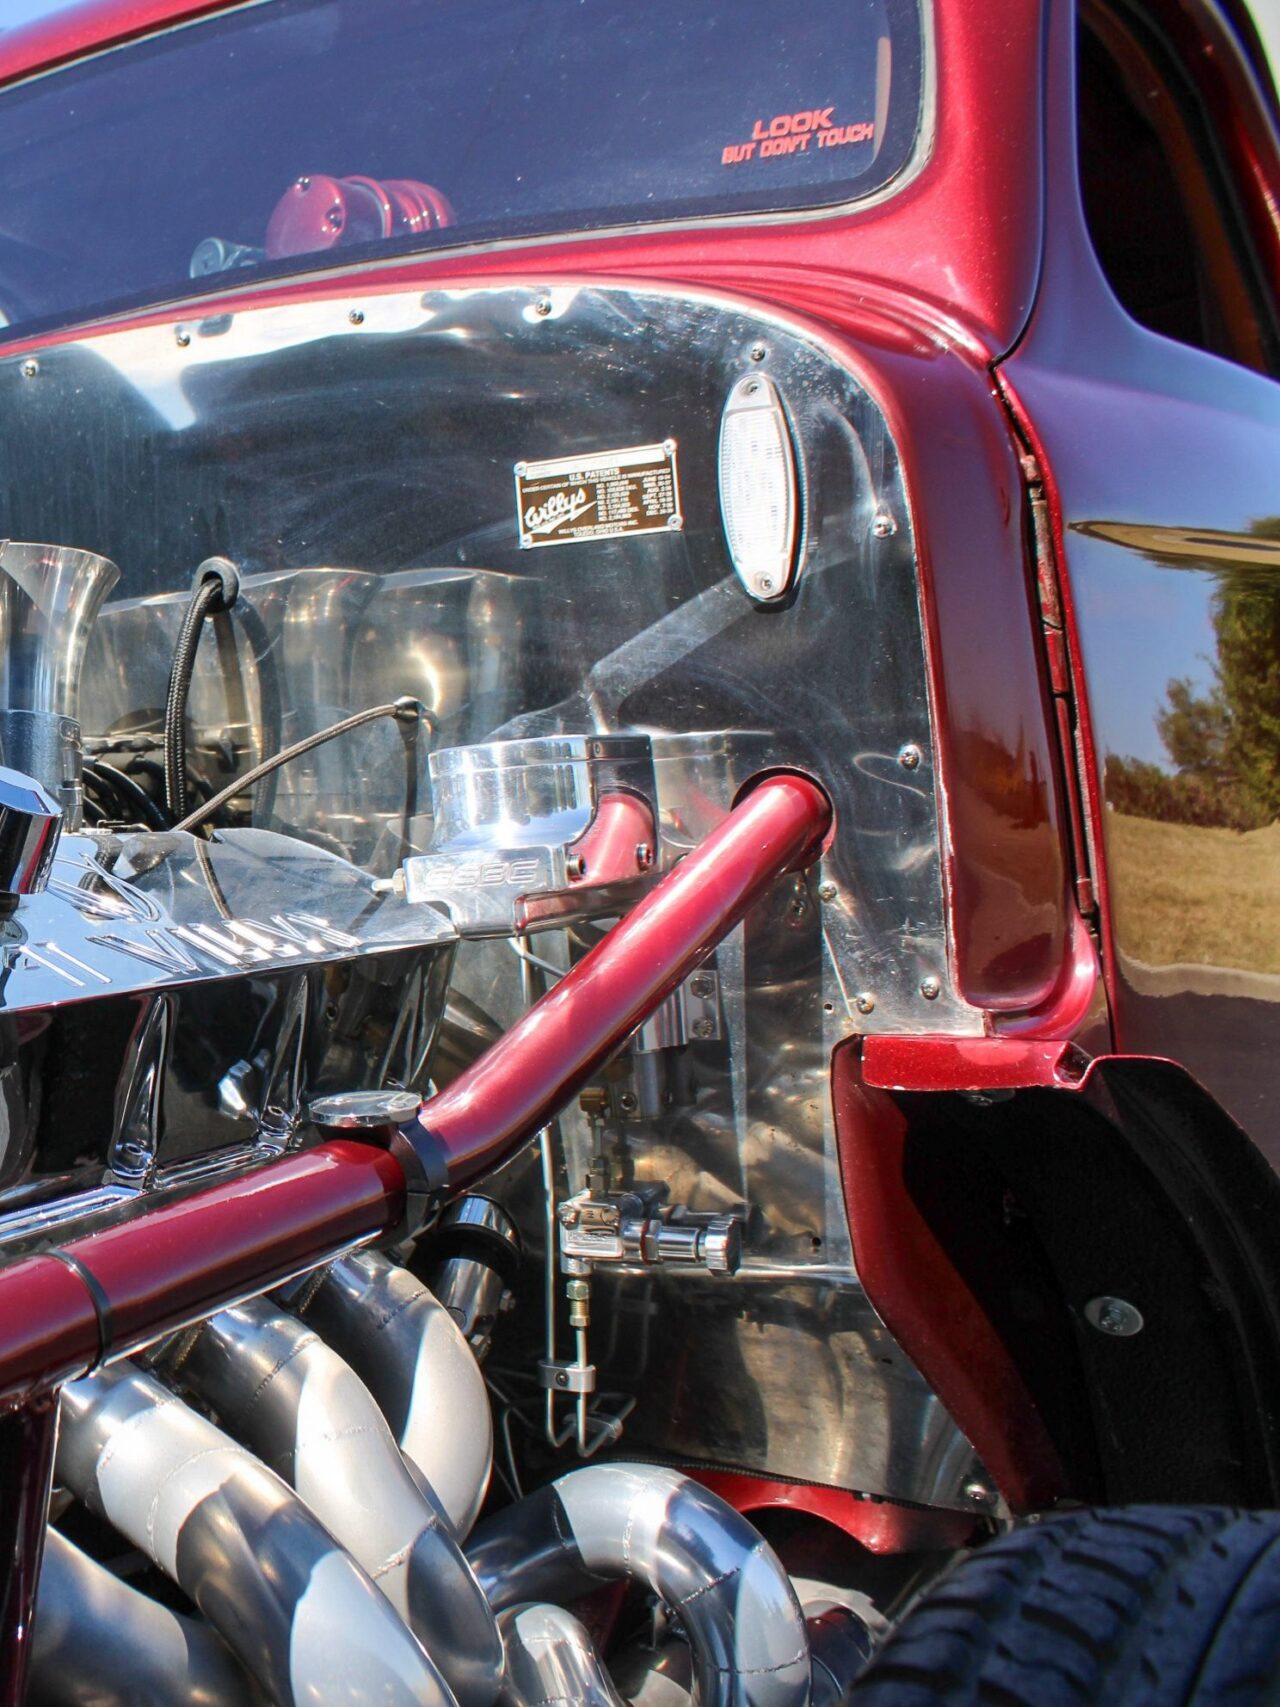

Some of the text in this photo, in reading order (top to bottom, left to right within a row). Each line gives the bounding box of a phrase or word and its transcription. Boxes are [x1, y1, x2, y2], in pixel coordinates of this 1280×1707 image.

[752, 107, 834, 140] LOOK
[721, 123, 874, 164] BUT DON'T TOUCH
[584, 467, 619, 478] PATENTS
[524, 487, 587, 529] Willys
